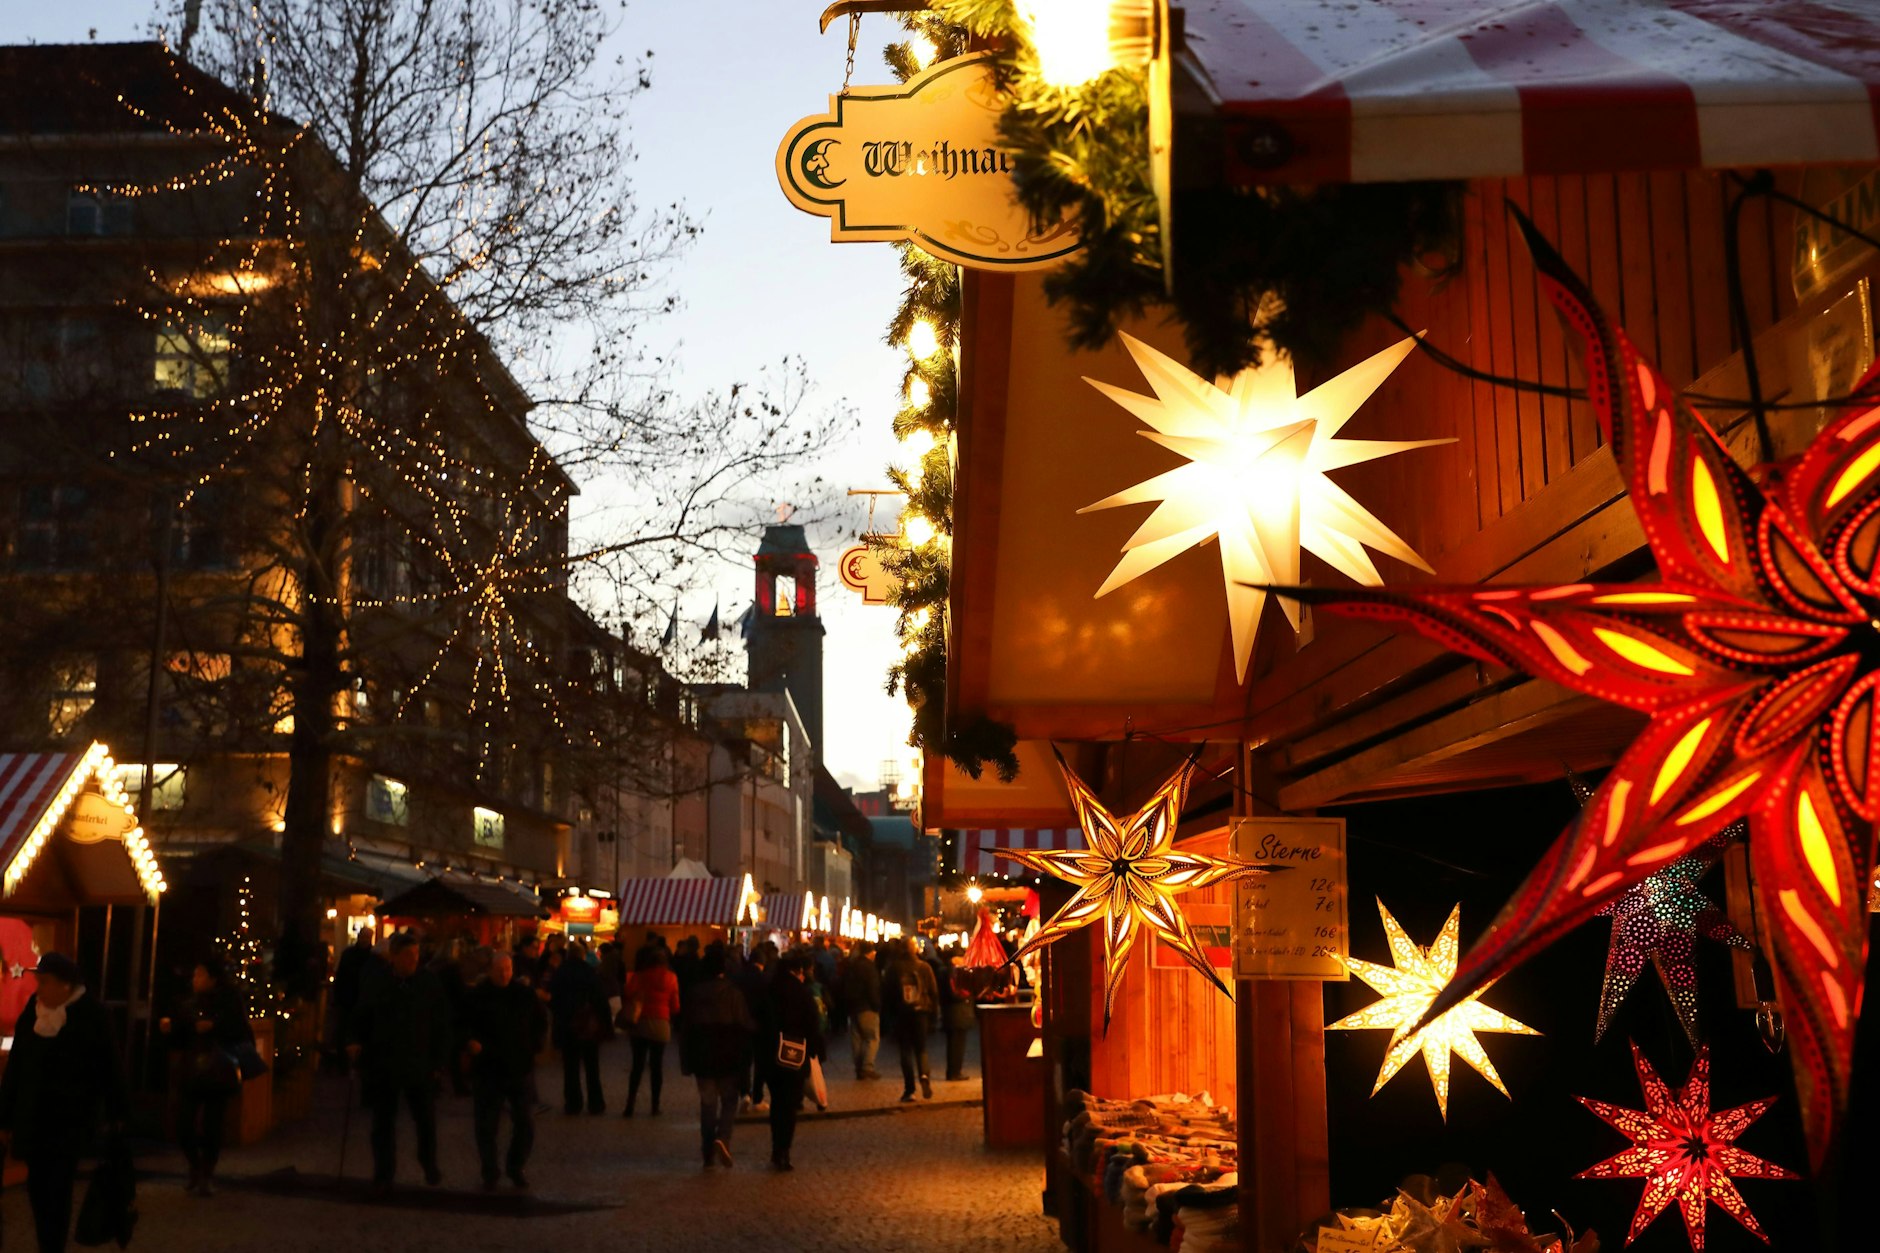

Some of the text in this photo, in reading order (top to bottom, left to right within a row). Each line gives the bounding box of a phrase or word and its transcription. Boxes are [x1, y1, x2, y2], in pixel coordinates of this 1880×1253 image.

[1255, 834, 1322, 861] Sterne
[1310, 879, 1336, 892] 12€
[1313, 926, 1337, 939] 16€
